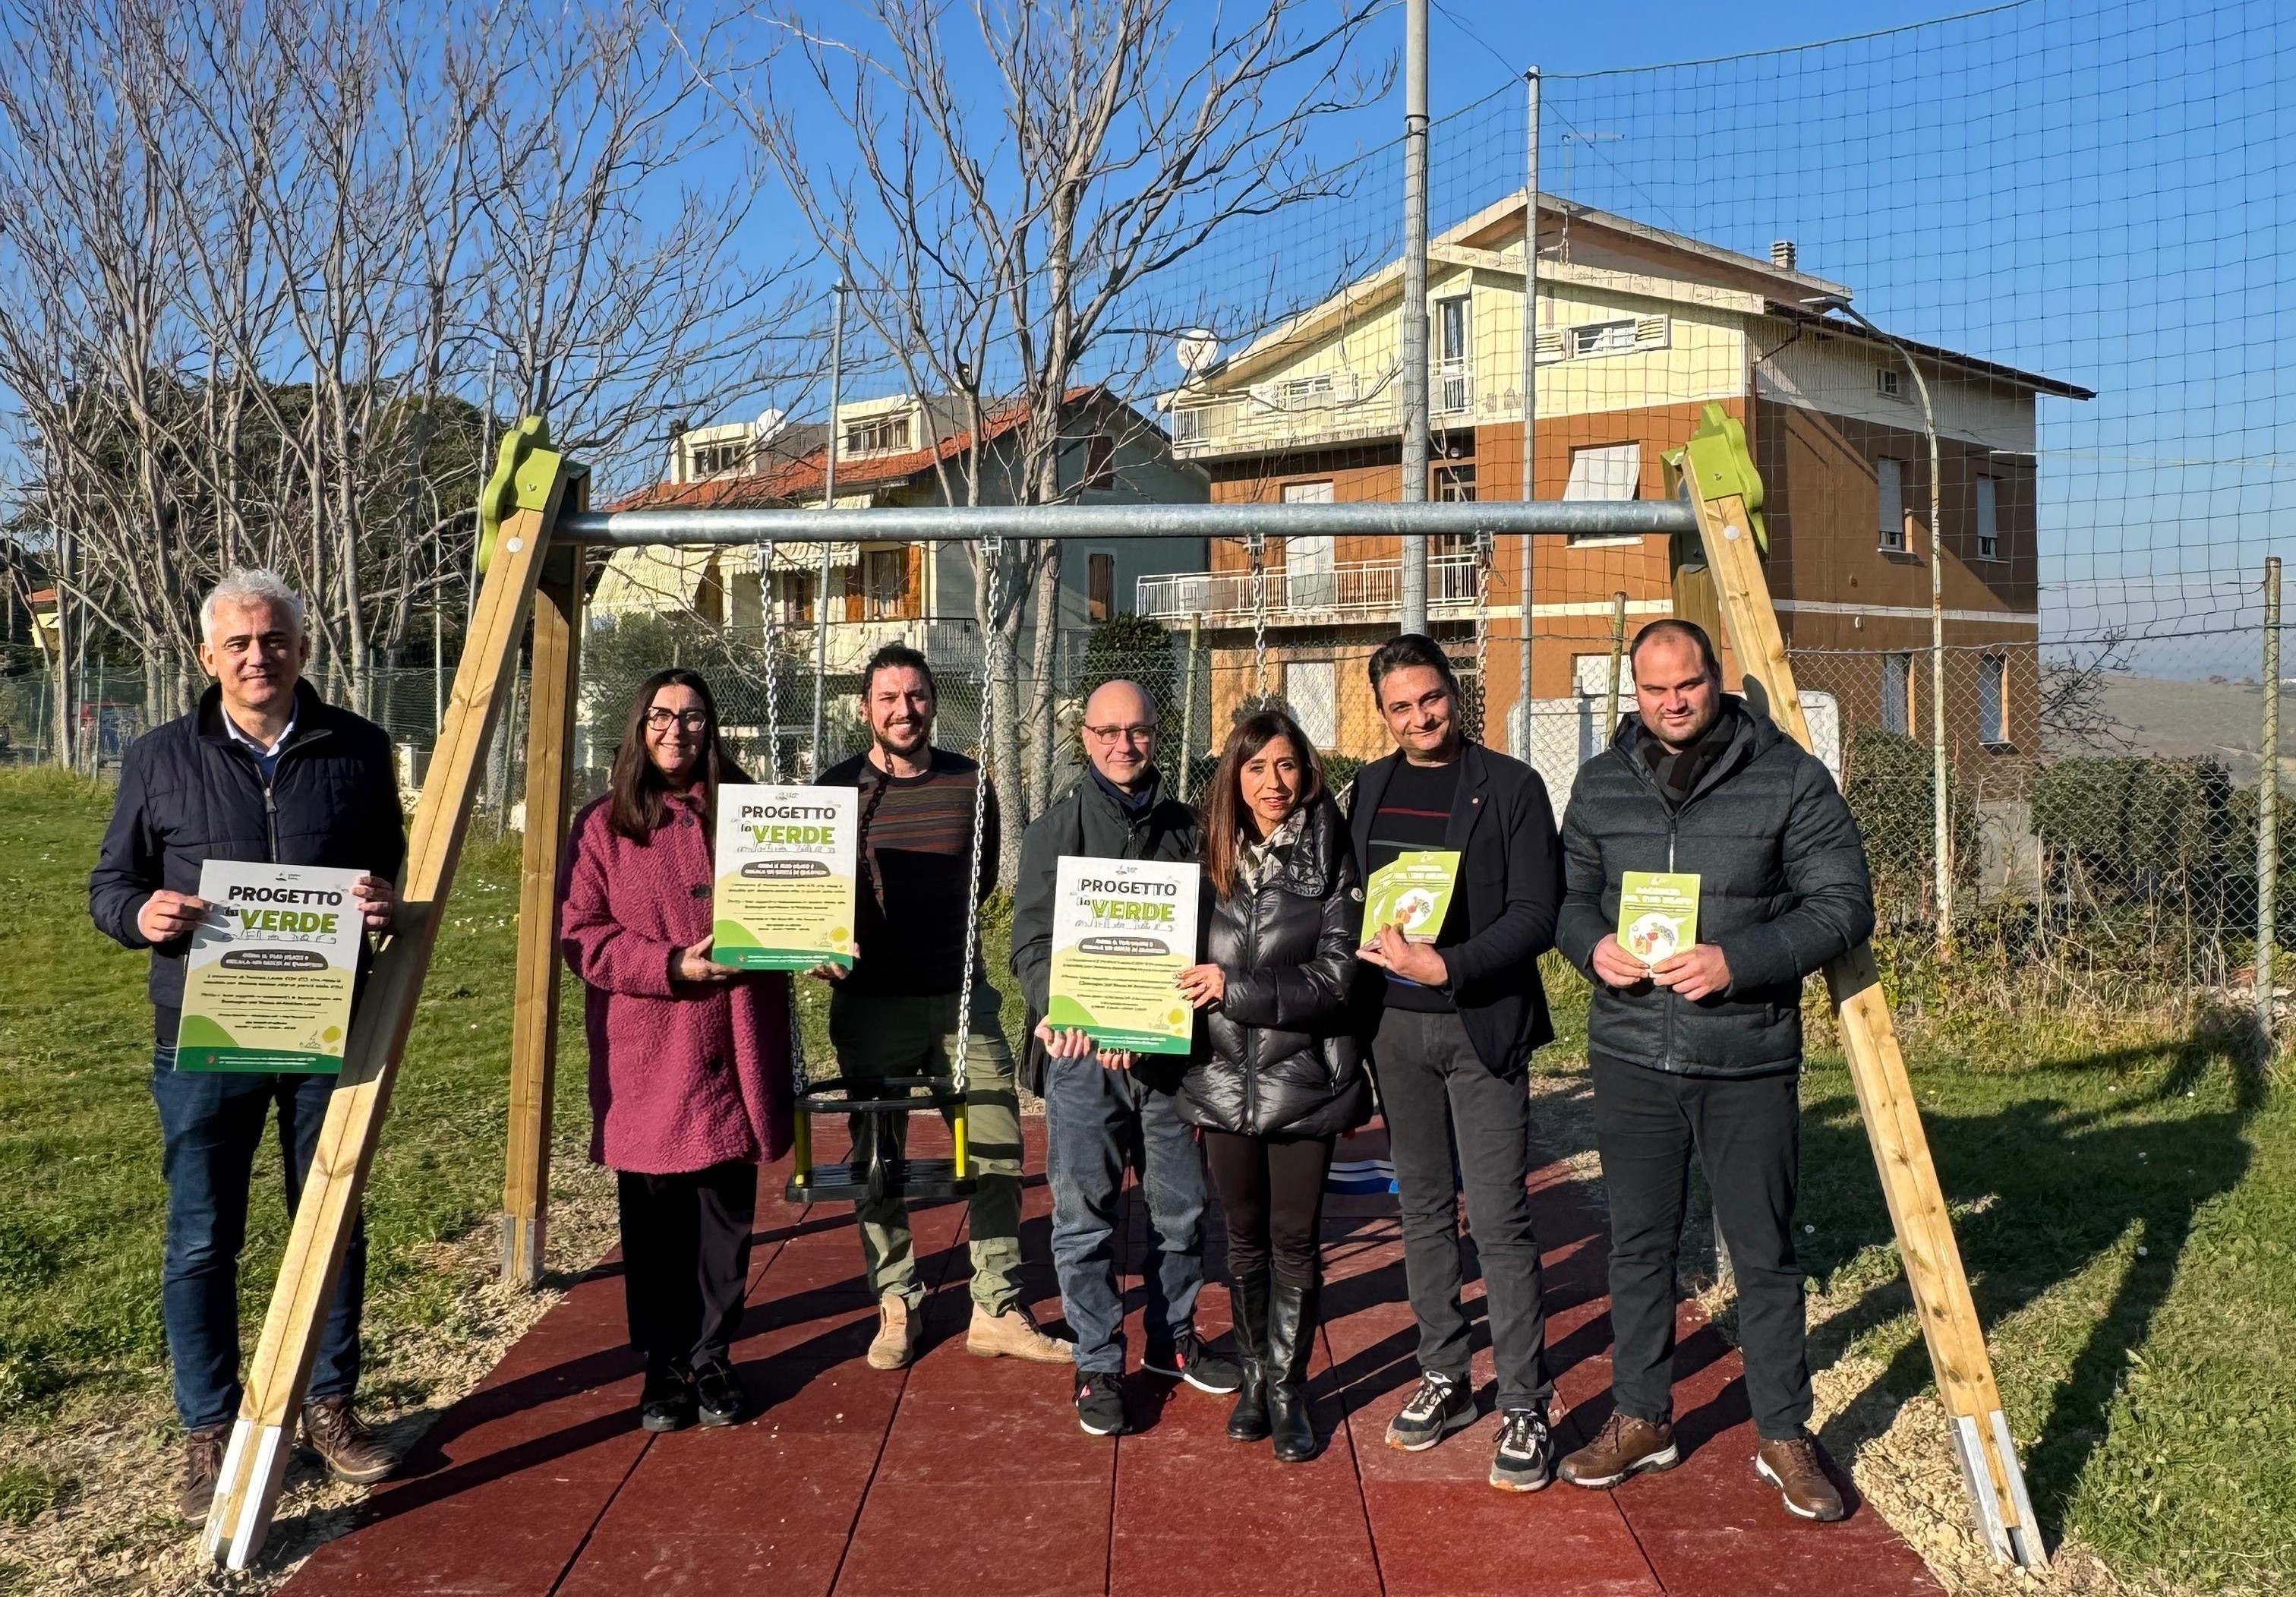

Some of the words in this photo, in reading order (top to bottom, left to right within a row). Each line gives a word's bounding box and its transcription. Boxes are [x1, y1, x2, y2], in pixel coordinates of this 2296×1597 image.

[742, 806, 836, 819] PROGETTO
[752, 825, 835, 844] VERDE
[229, 885, 342, 906] PROGETTO
[1081, 879, 1177, 896] PROGETTO
[1093, 899, 1175, 922] VERDE
[241, 909, 339, 933] VERDE
